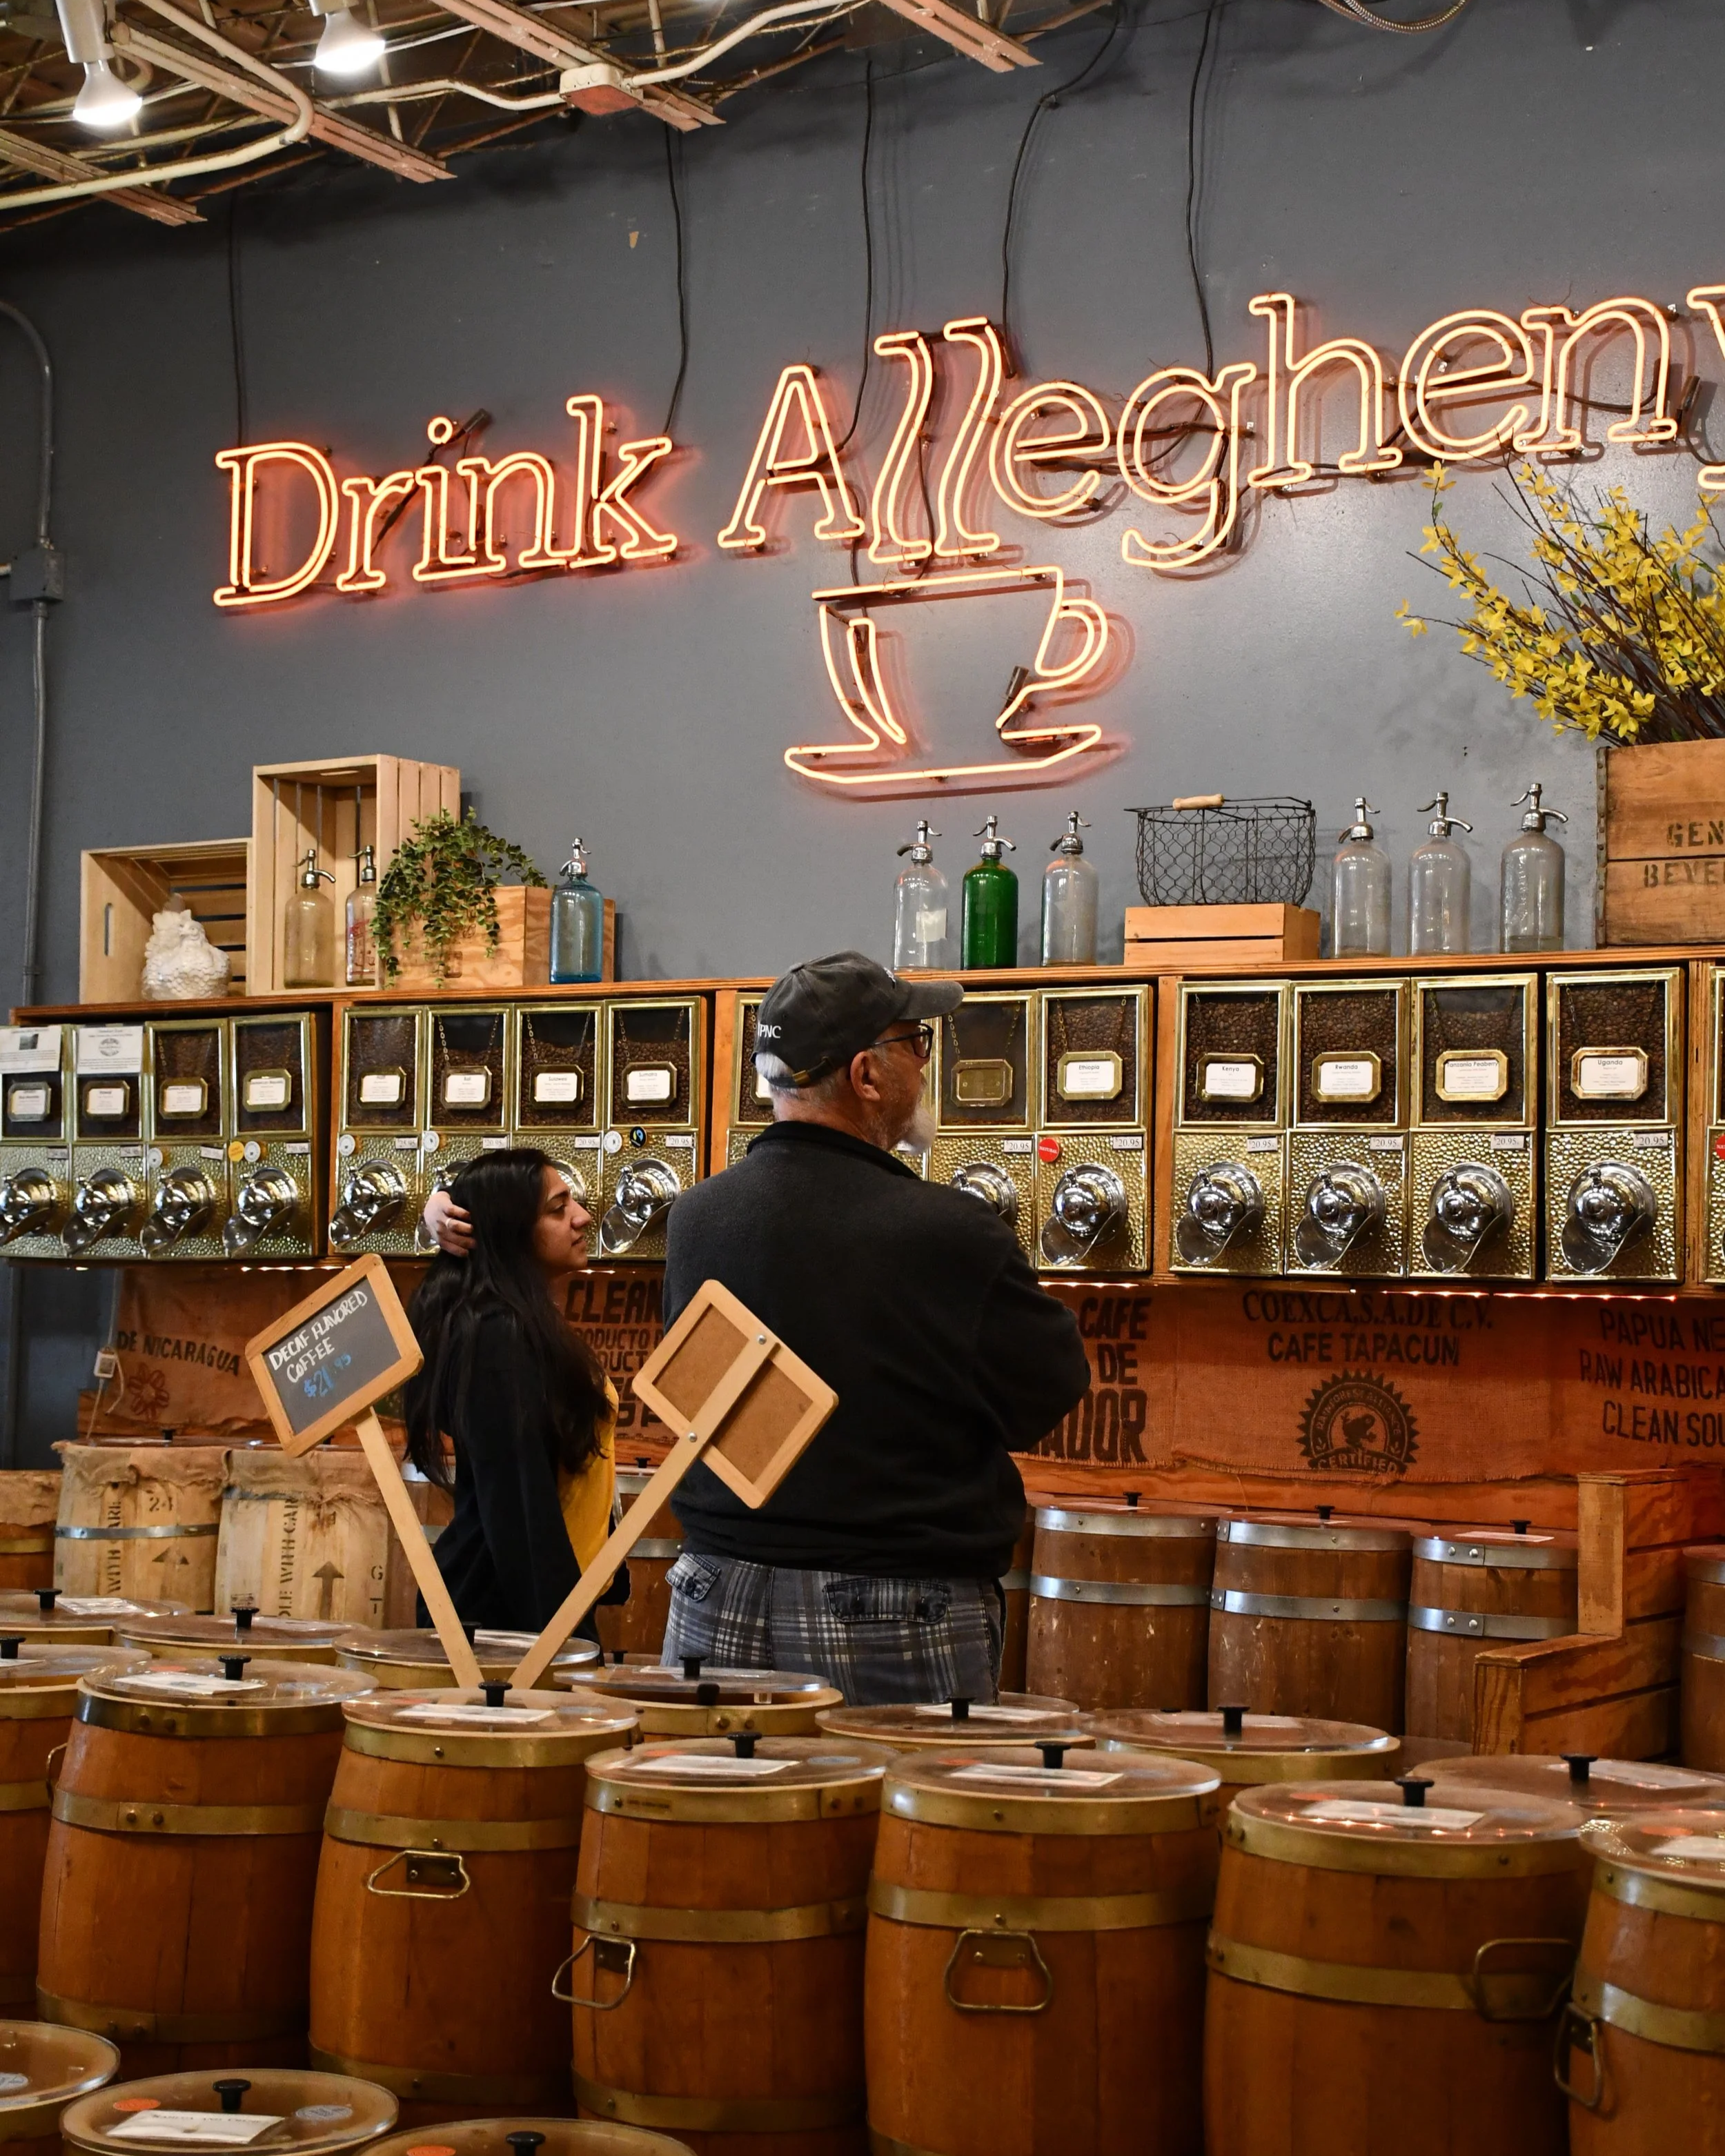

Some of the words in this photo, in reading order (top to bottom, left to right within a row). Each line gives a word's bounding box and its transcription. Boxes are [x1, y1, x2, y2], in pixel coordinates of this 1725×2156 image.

[213, 394, 678, 606] Drink
[1644, 860, 1725, 889] BEVE
[760, 1024, 782, 1038] PNC
[1005, 1141, 1029, 1151] $20.95
[1038, 1146, 1058, 1154] NATURAL
[1115, 1138, 1139, 1147] $20.95
[564, 1279, 664, 1325] CLEAN
[1078, 1297, 1152, 1340] CAFE
[268, 1329, 310, 1371] DECAF
[310, 1290, 368, 1341] FLAVORED
[1341, 1333, 1459, 1367] TAPACUN
[1599, 1308, 1685, 1350] PAPUA
[117, 1330, 137, 1352] DE
[142, 1334, 241, 1377] NICARAGUA
[286, 1336, 335, 1383] COFFEE
[1097, 1343, 1138, 1385] DE
[1579, 1348, 1622, 1389] RAW
[1602, 1400, 1679, 1445] CLEAN
[1317, 1450, 1397, 1474] CERTIFIED
[279, 1539, 295, 1584] WITH
